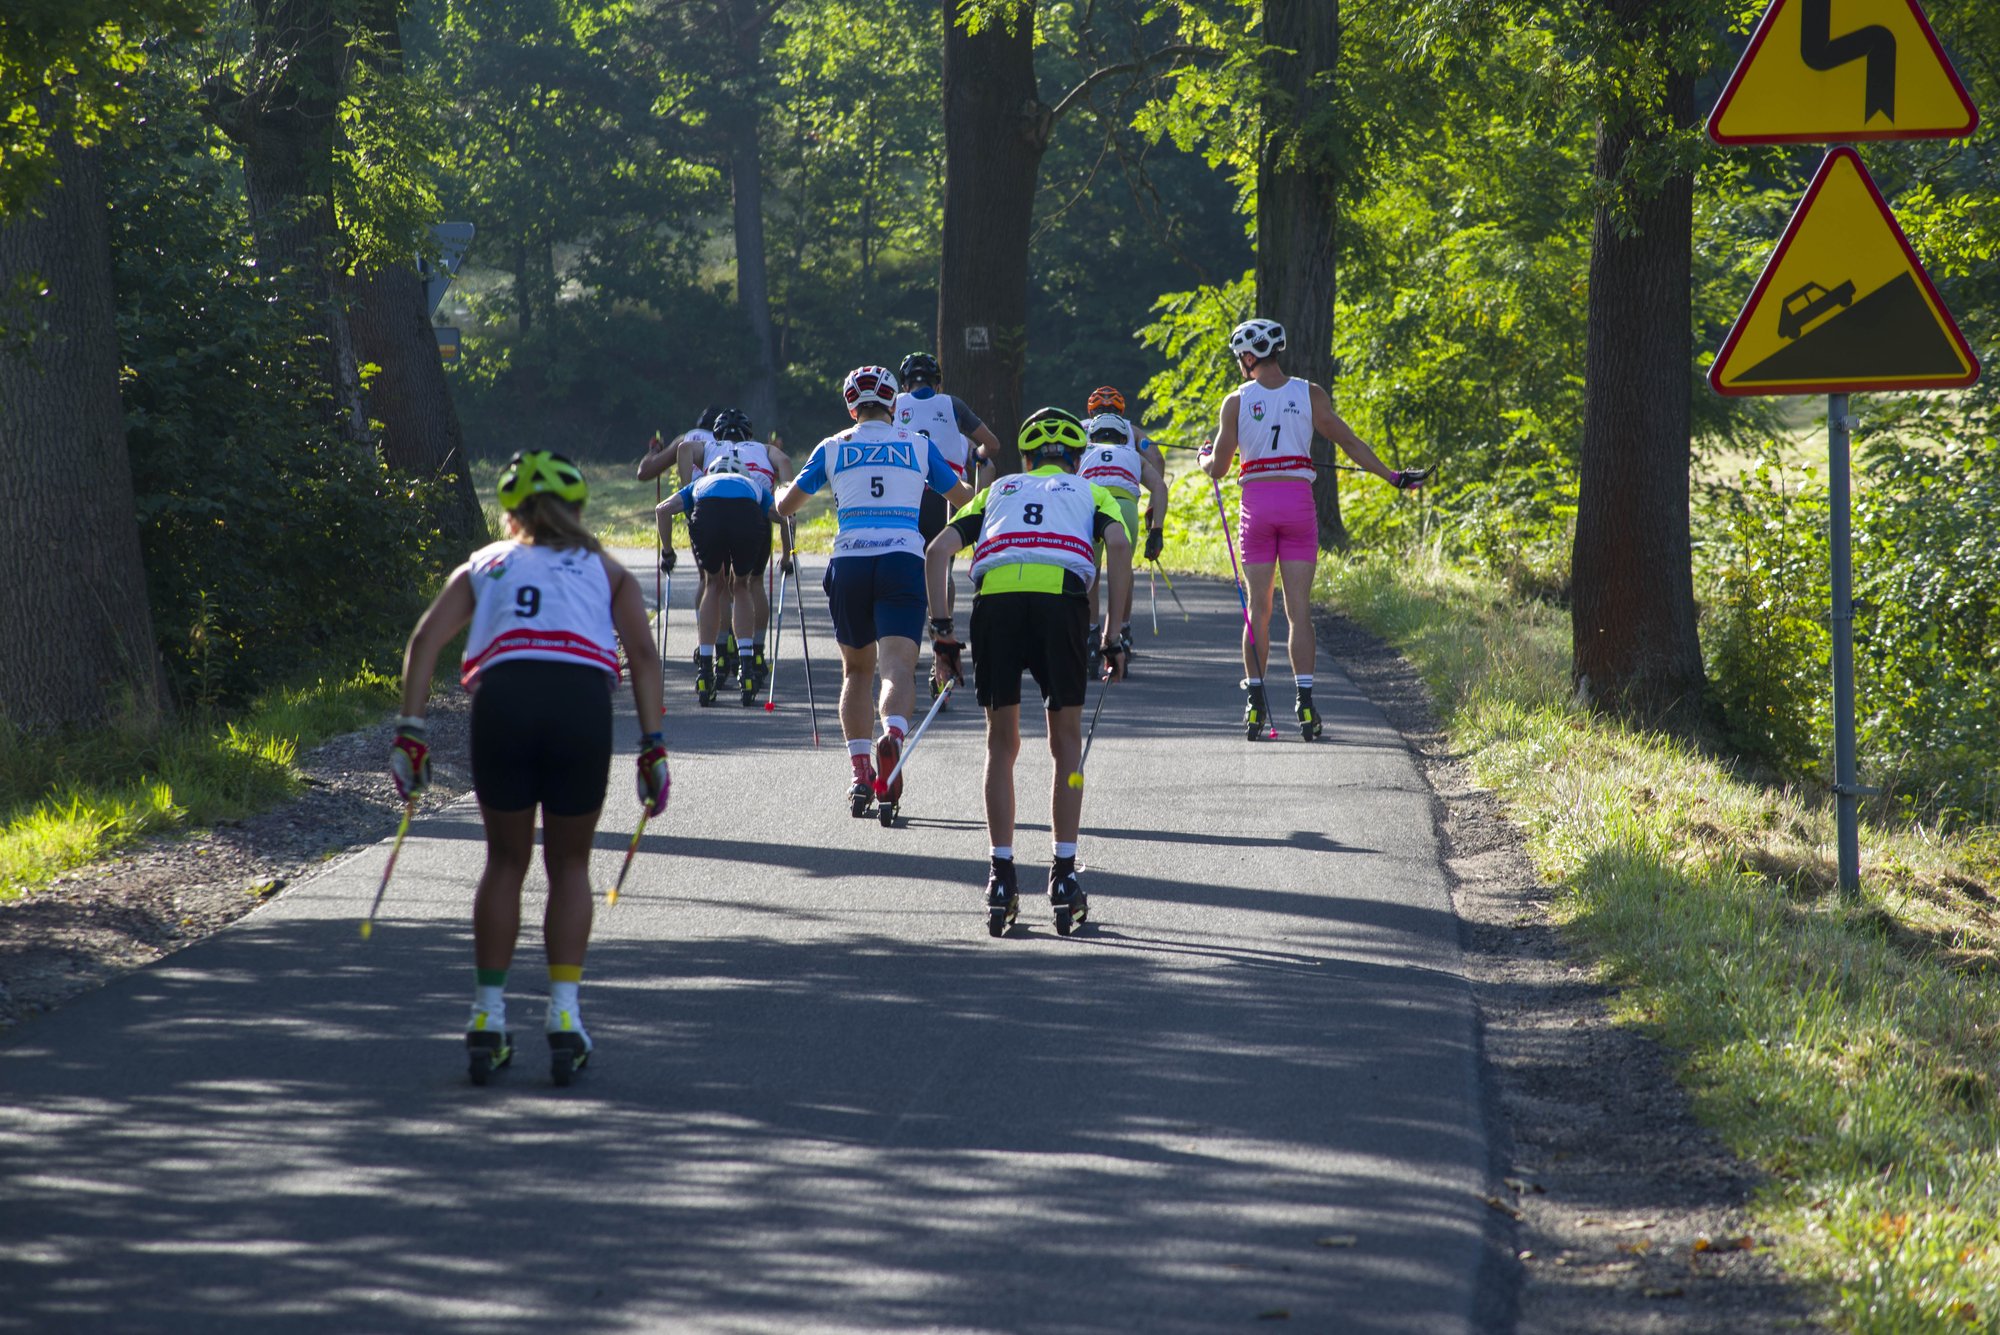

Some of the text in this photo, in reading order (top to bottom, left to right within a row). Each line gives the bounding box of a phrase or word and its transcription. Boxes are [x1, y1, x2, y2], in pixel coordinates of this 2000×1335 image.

[1271, 424, 1281, 450] 7
[842, 444, 911, 468] DZN
[1101, 450, 1113, 462] 6
[870, 476, 884, 498] 5
[1023, 503, 1044, 526] 8
[515, 585, 541, 618] 9
